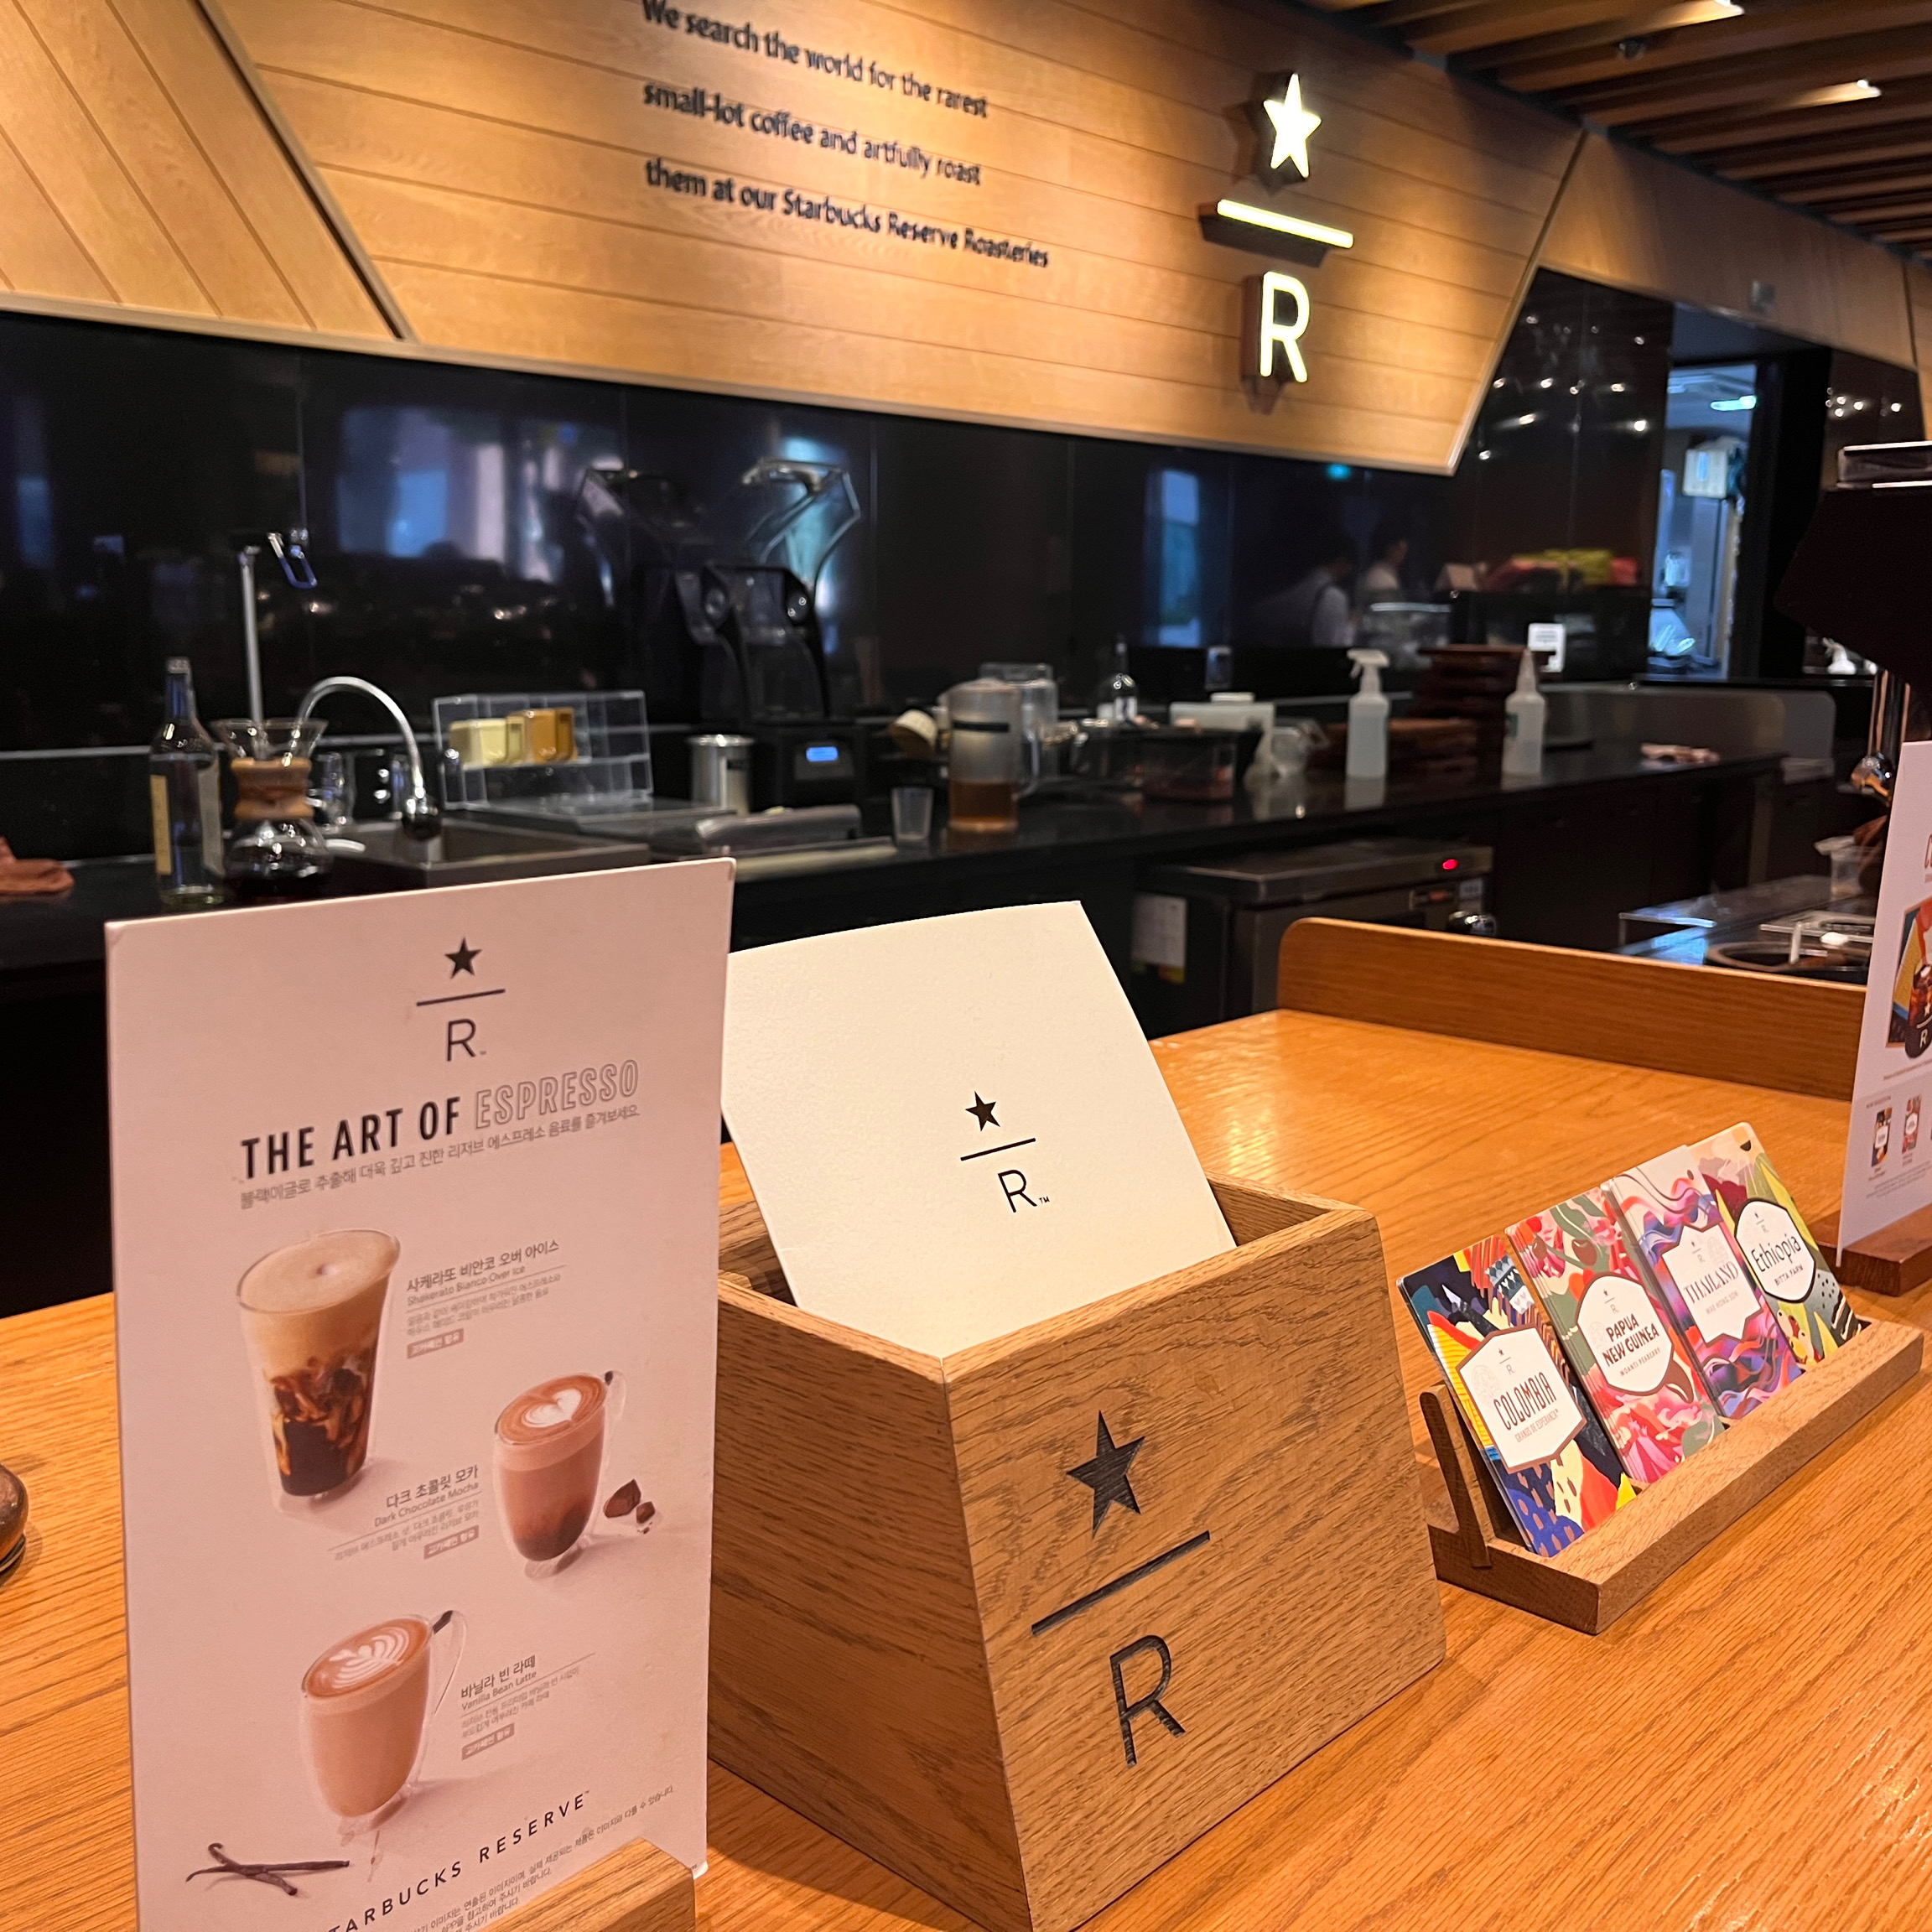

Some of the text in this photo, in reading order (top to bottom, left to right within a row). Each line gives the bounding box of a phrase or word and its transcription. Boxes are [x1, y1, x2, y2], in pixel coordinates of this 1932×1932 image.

[643, 0, 988, 118] We search the world for the rarest
[643, 83, 981, 185] small-lot coffee and artfully roast
[645, 157, 1049, 268] them at our Starbucks Reserve Roasteries
[1260, 271, 1310, 383] R
[241, 1059, 640, 1179] THE ART OF ESPRESSO
[419, 1149, 444, 1167] 진한
[449, 1140, 485, 1159] 리저브
[488, 1127, 547, 1150] 에스프레소
[407, 1239, 560, 1292] 사케라또 비안코 오버 아이스
[1751, 1233, 1801, 1272] Ethiopia
[1683, 1261, 1738, 1303] THAILAND
[1602, 1323, 1659, 1367] NEW GUINEA
[1606, 1313, 1639, 1343] PAPUA
[1493, 1372, 1557, 1431] COLOMBIA
[375, 1482, 479, 1527] Dark Chocolate Mocha
[387, 1465, 478, 1508] 다크 초콜릿 모카
[461, 1654, 535, 1698] 바닐라 빈 라떼
[461, 1671, 537, 1711] Vanilla Bean Latte
[1110, 1634, 1186, 1768] R
